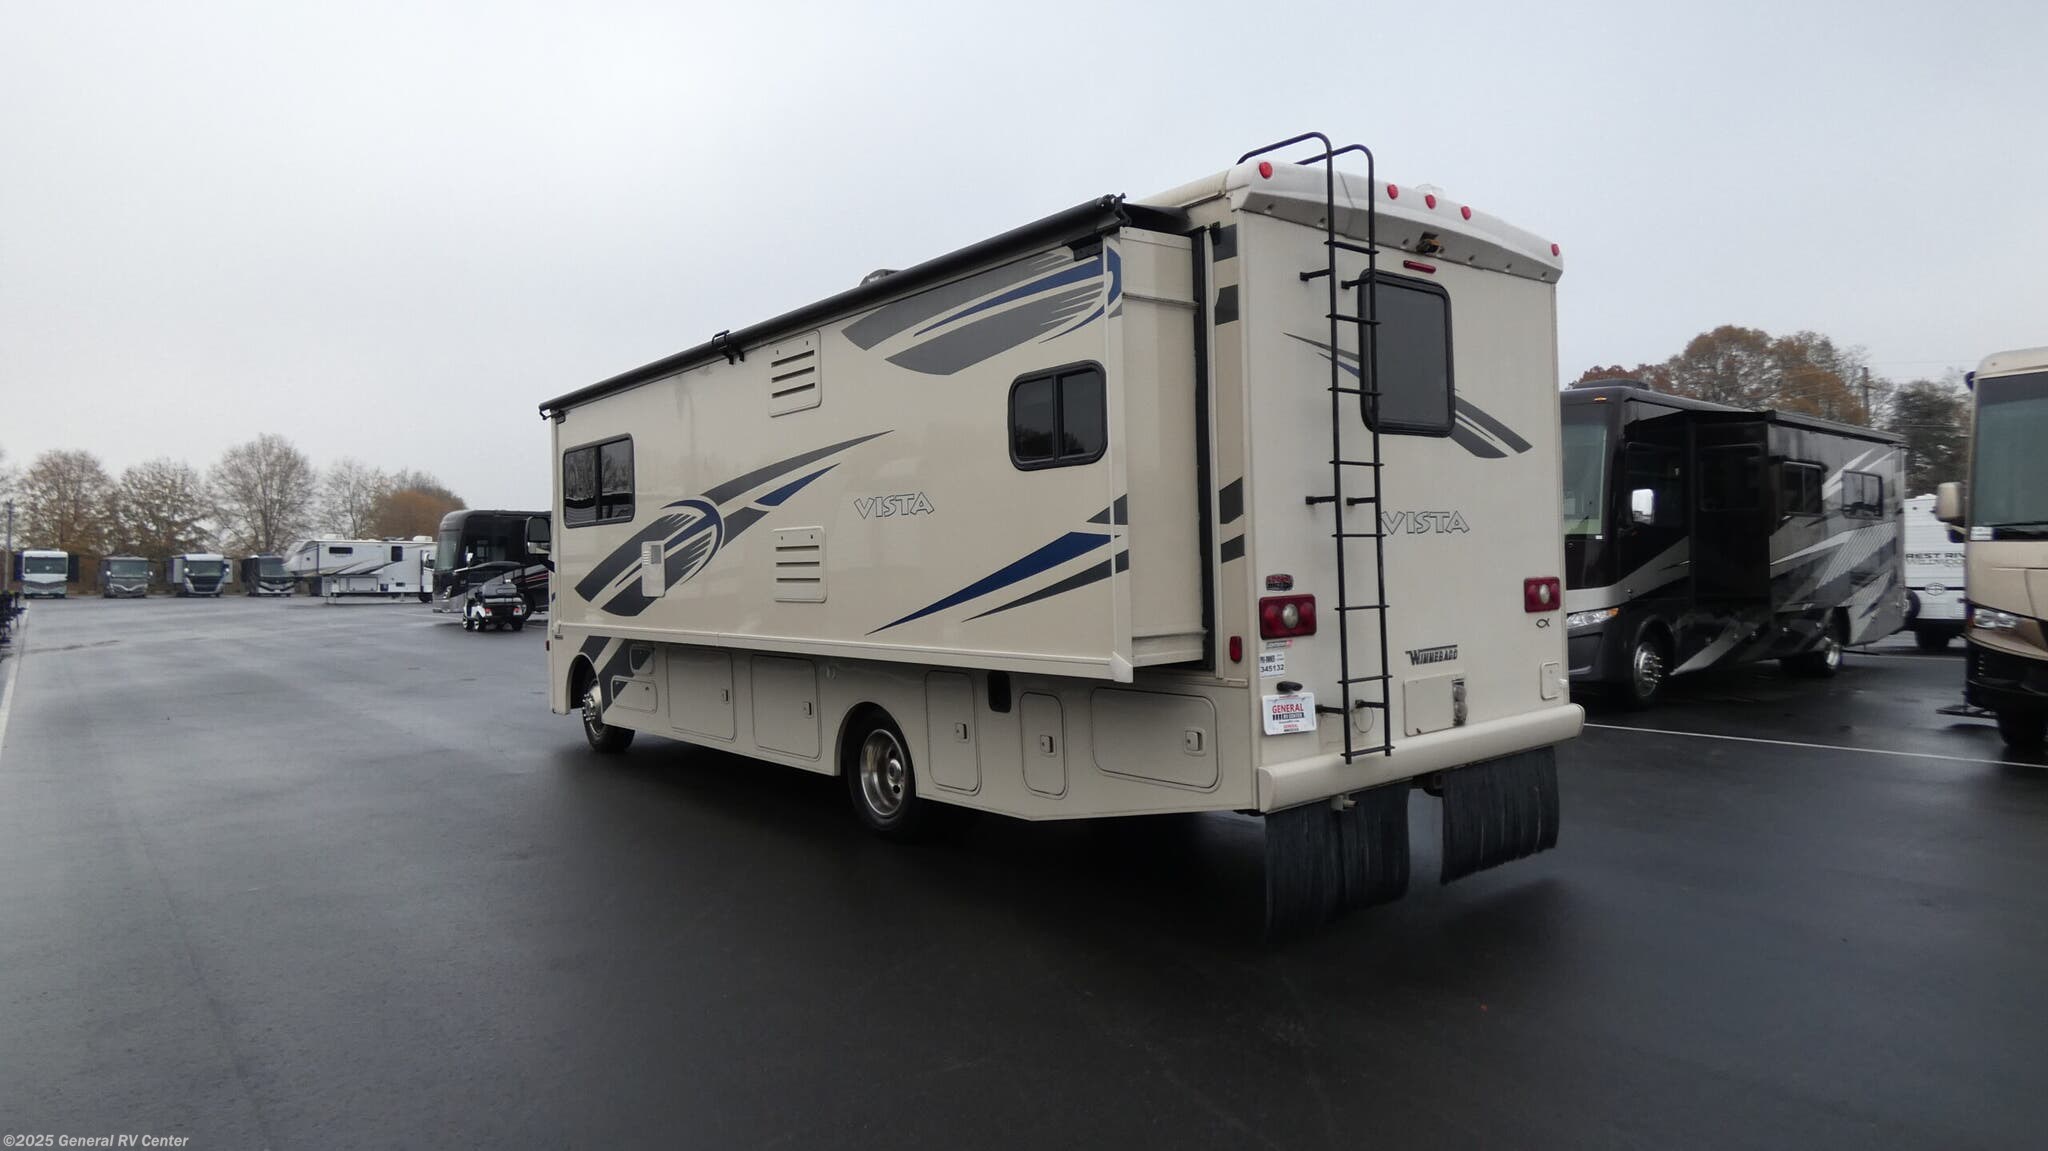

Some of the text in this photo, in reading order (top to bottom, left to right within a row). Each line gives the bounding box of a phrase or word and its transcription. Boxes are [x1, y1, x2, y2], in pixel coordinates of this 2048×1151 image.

[854, 491, 935, 519] VISTA
[1380, 510, 1470, 535] VISTA
[1272, 703, 1304, 713] GENERAL
